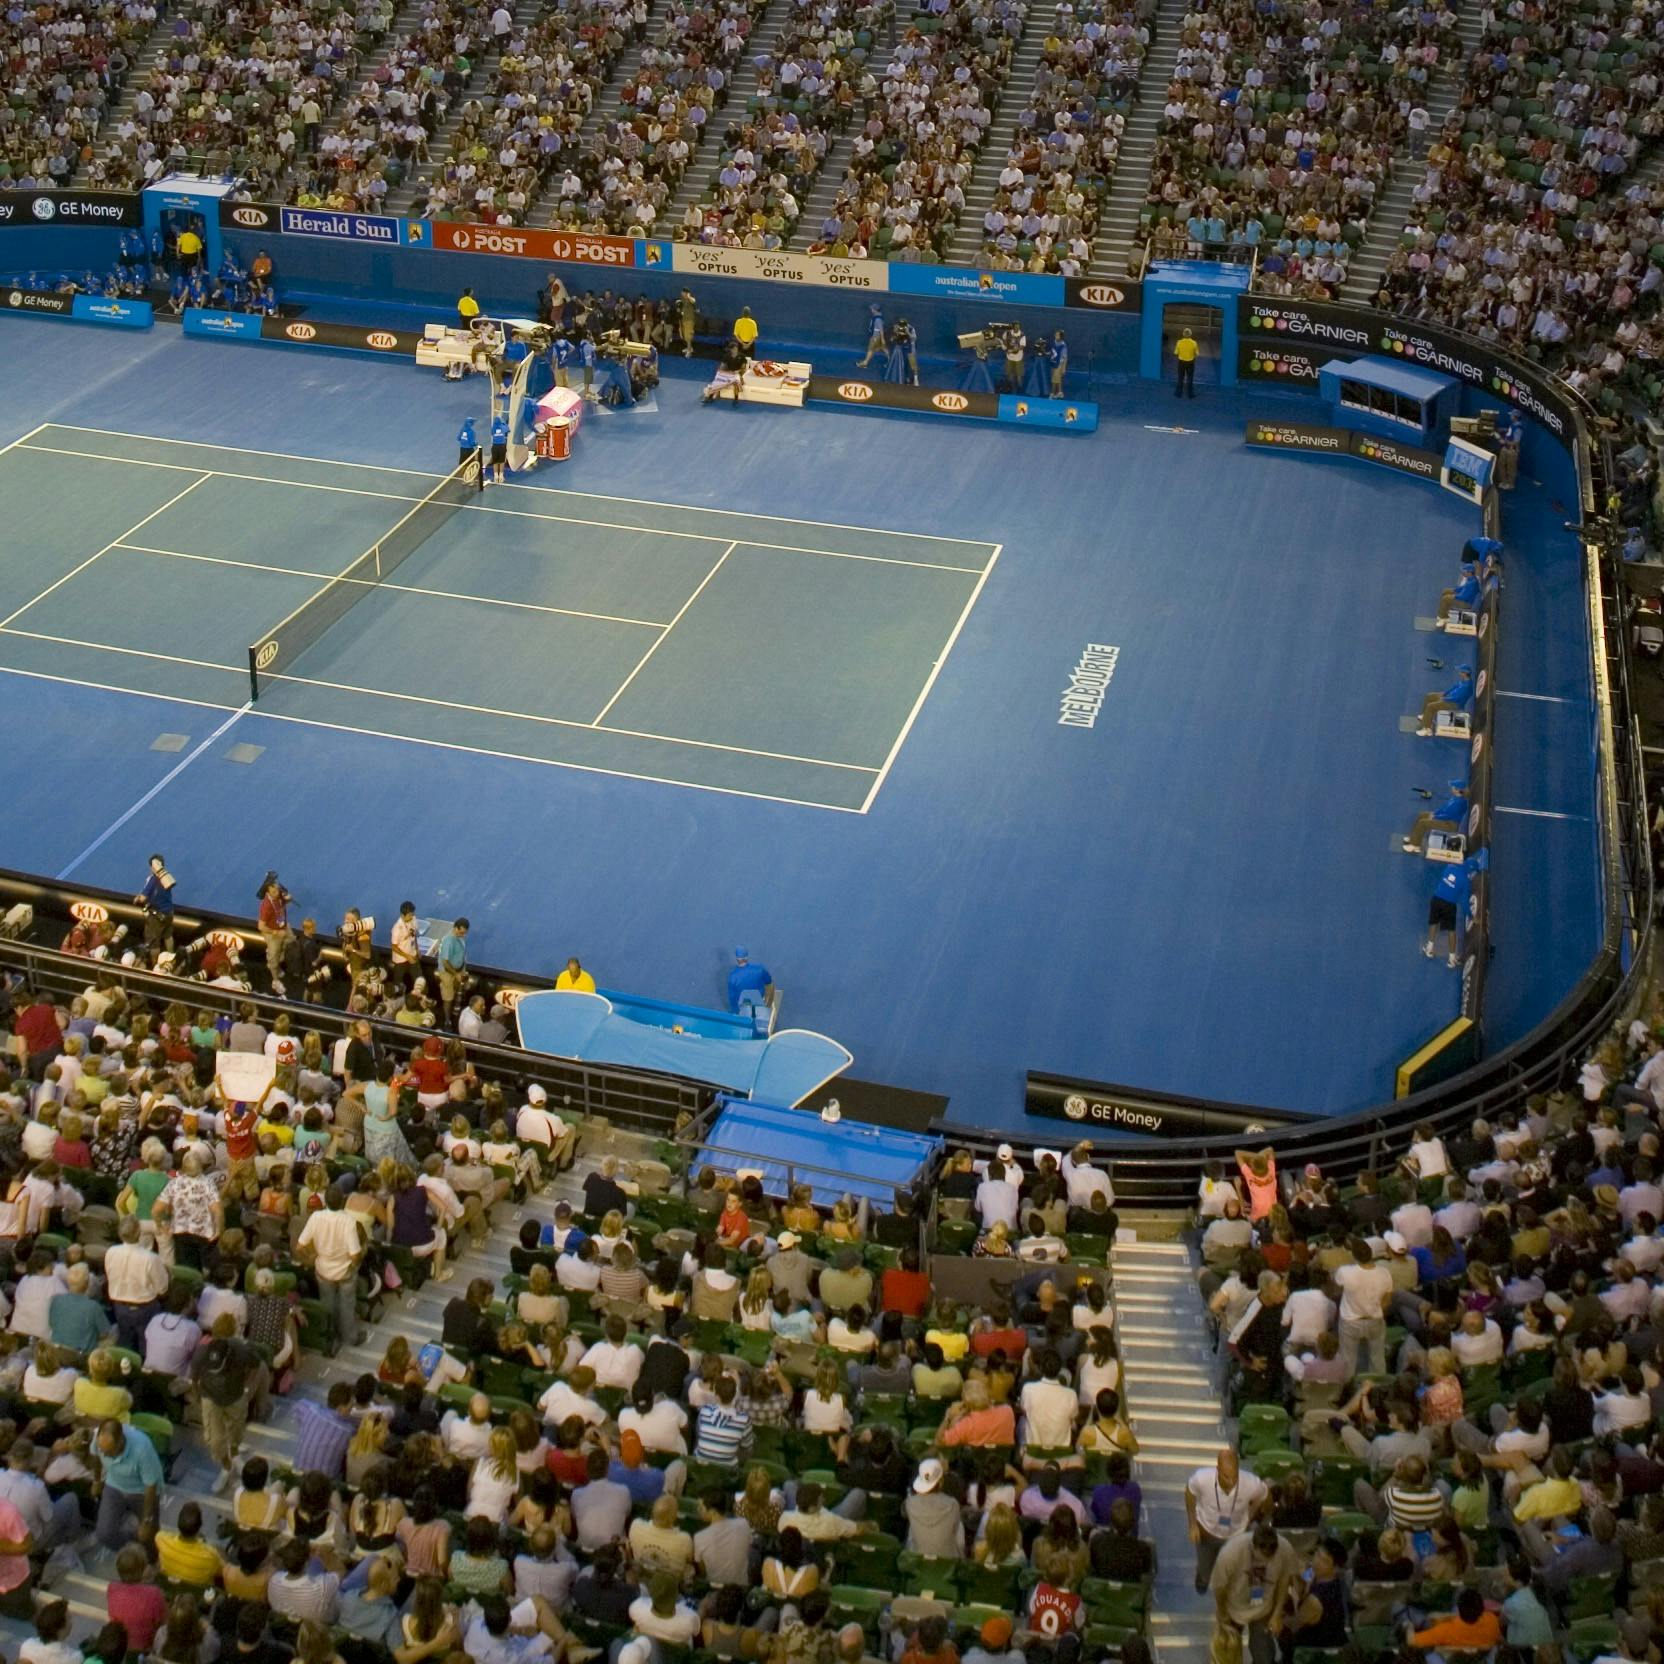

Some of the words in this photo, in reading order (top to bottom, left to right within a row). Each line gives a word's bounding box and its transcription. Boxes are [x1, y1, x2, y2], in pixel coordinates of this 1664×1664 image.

[59, 202, 79, 216] GE
[81, 203, 124, 220] Money
[237, 210, 265, 224] KIA
[288, 212, 351, 236] Herald
[355, 216, 392, 239] Sun
[474, 234, 527, 254] POST
[575, 243, 630, 263] POST
[697, 262, 738, 274] OPTUS
[763, 268, 804, 280] OPTUS
[829, 274, 870, 287] OPTUS
[935, 275, 979, 288] australian
[993, 281, 1017, 292] open
[24, 295, 36, 306] GE
[36, 297, 64, 309] Money
[1087, 287, 1117, 304] KIA
[1252, 306, 1279, 319] Take
[1282, 310, 1310, 322] care.
[290, 324, 313, 337] KIA
[1288, 319, 1369, 346] GARNIER
[1383, 327, 1408, 342] Take
[1409, 336, 1436, 350] care.
[370, 334, 394, 348] KIA
[1253, 350, 1280, 362] Take
[1283, 354, 1309, 365] care.
[1415, 347, 1484, 384] GARNIER
[1494, 366, 1513, 382] Take
[843, 384, 868, 398] KIA
[937, 394, 964, 409] KIA
[1518, 390, 1564, 435] GARNIER
[1258, 424, 1278, 434] Take
[1282, 433, 1339, 448] GARNIER
[1363, 438, 1378, 447] Take
[1382, 449, 1433, 474] GARNIER
[1451, 447, 1482, 476] IBM
[258, 642, 278, 667] KIA
[1060, 643, 1118, 727] MELBOURNE
[76, 904, 103, 921] KIA
[1091, 1103, 1112, 1120] GE
[1113, 1107, 1163, 1131] Money
